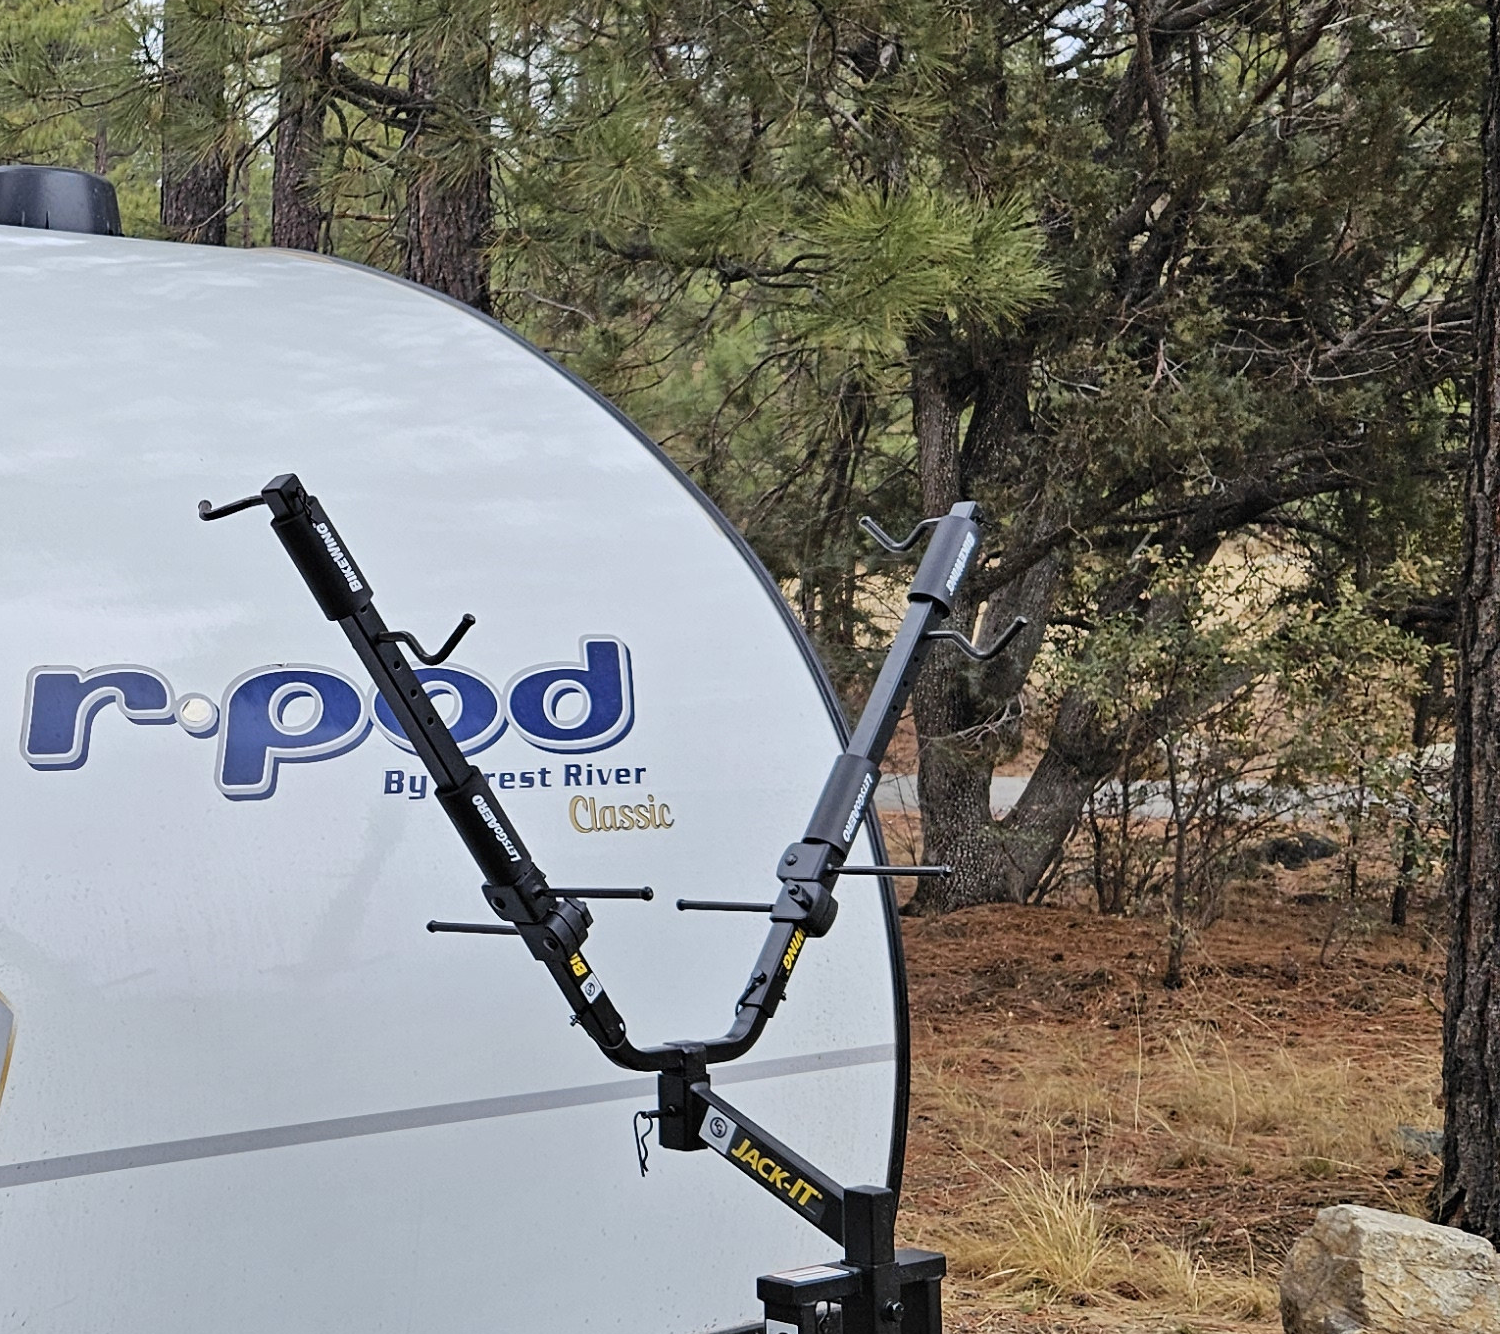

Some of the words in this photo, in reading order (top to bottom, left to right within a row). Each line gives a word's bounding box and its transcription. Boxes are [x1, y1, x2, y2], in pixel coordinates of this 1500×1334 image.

[315, 522, 363, 593] BIKEWING
[946, 531, 975, 593] BIKEWING
[384, 769, 428, 800] By
[484, 767, 552, 789] rest
[564, 763, 647, 787] River
[569, 794, 675, 833] Classic
[783, 928, 806, 970] WING
[731, 1138, 821, 1206] JACK-IT
